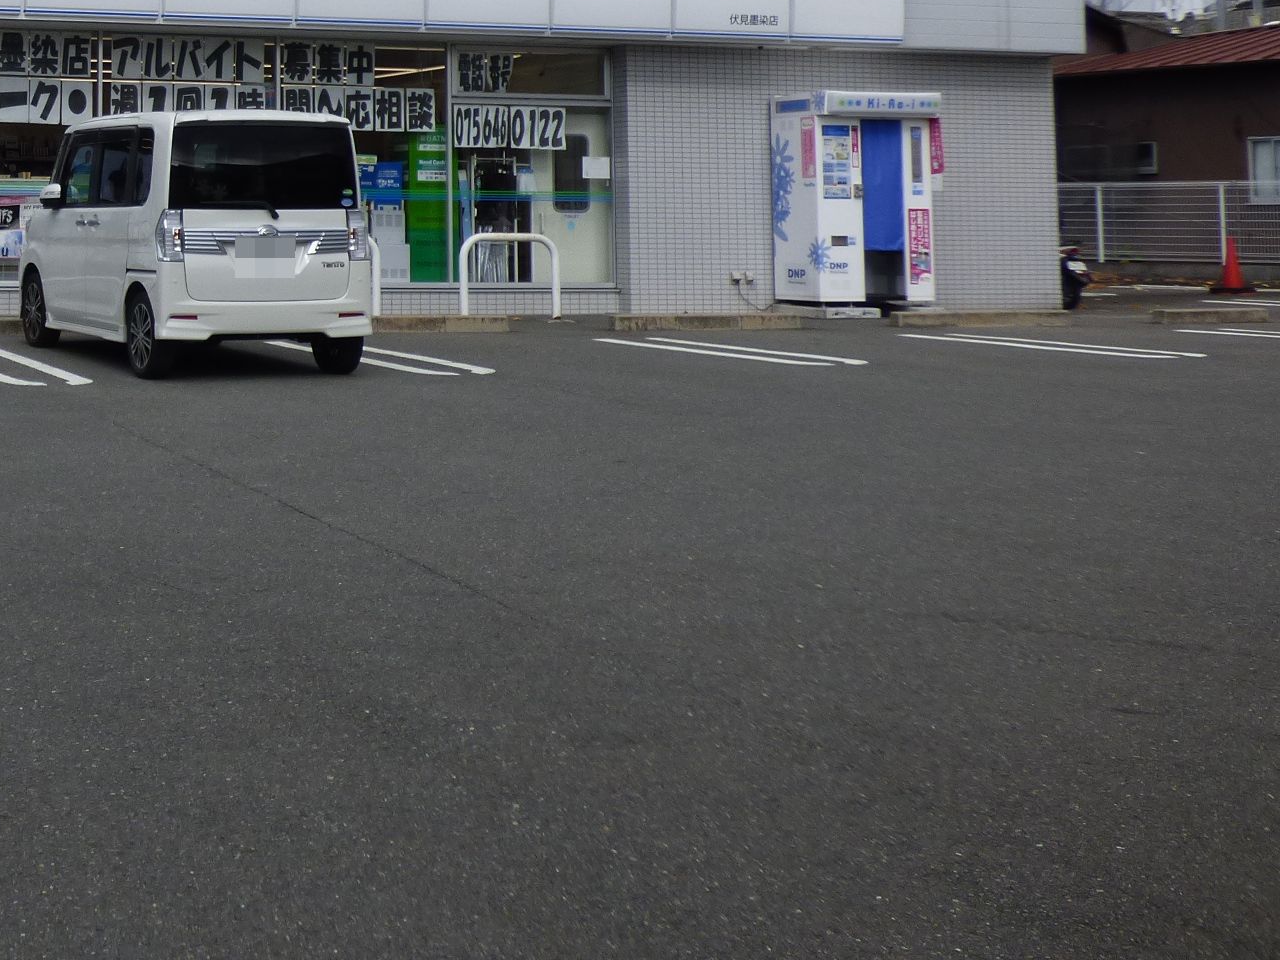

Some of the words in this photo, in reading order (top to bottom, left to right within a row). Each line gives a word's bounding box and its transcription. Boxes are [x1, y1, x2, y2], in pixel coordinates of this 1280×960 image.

[729, 14, 779, 26] 伏見墨染店
[113, 37, 262, 81] アルバイト
[285, 42, 373, 85] 募集中
[829, 262, 849, 270] DNP
[787, 269, 806, 279] DNP
